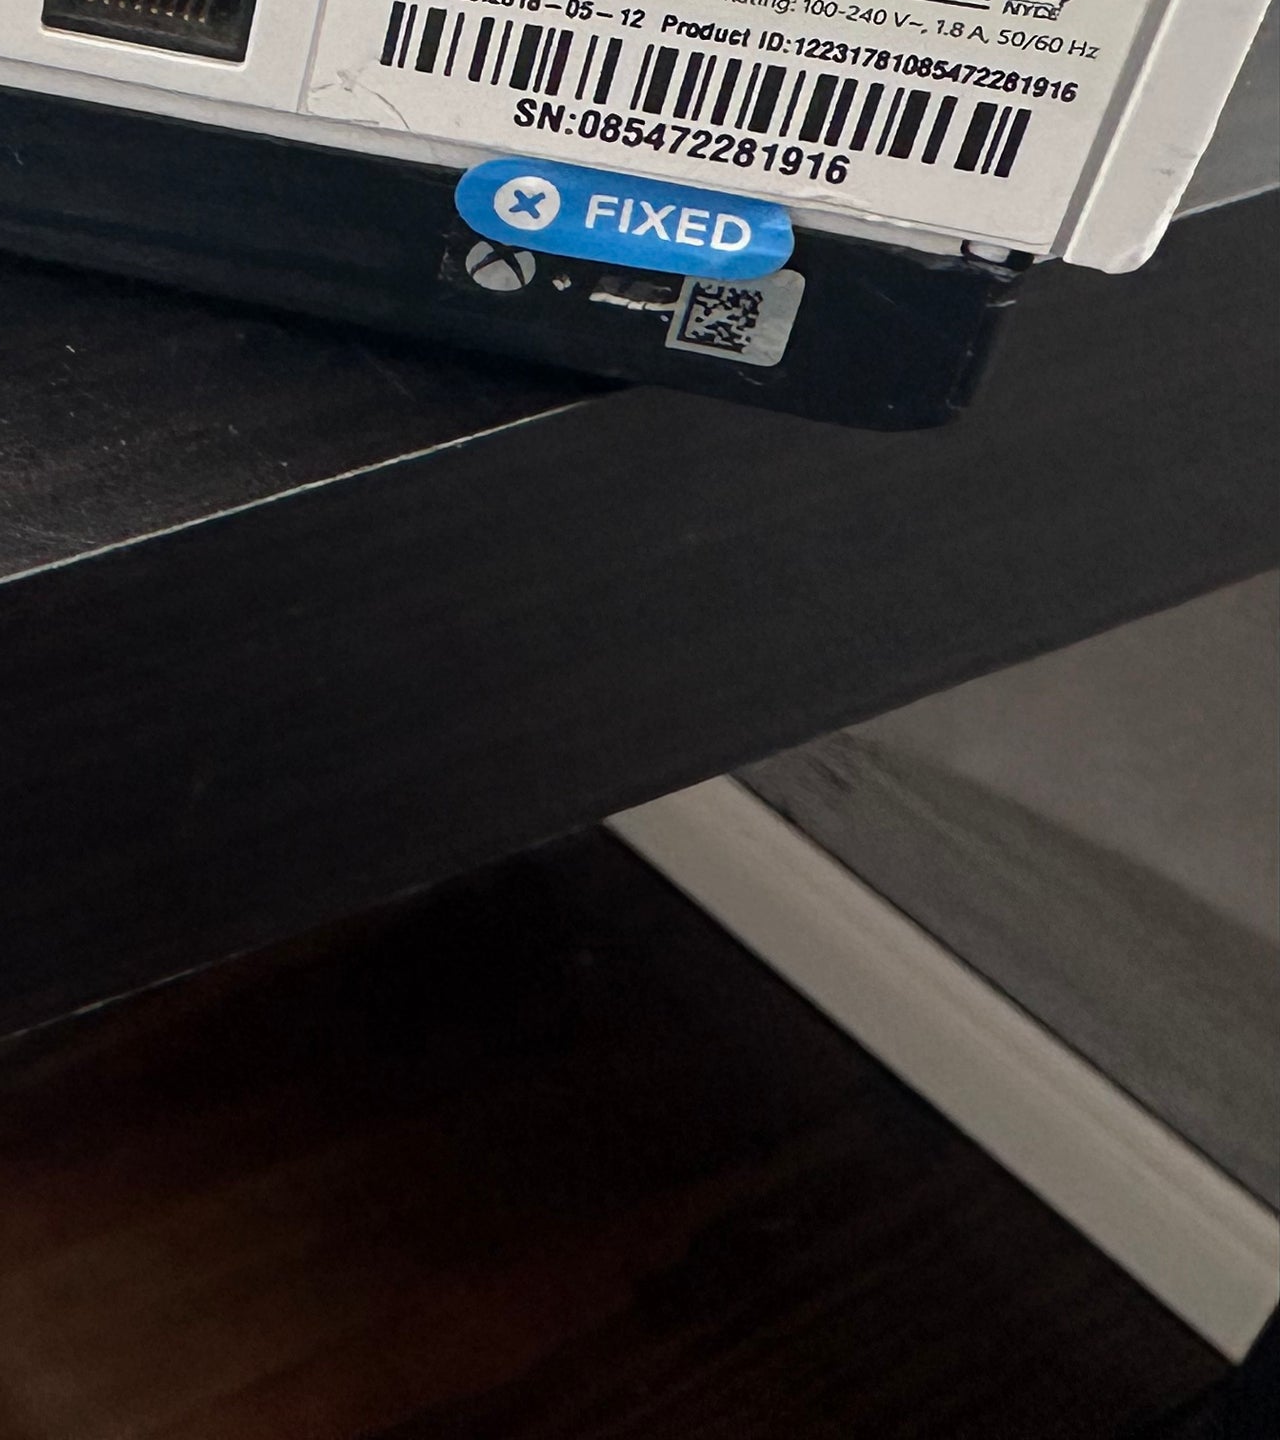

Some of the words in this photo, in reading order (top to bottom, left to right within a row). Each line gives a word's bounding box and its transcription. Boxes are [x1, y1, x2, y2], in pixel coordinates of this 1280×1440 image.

[660, 14, 752, 47] Product
[936, 19, 964, 38] 1.8
[997, 28, 1064, 54] 50/60
[1068, 40, 1100, 60] Hz
[513, 97, 851, 185] SN:085472281916
[584, 194, 752, 251] FIXED
